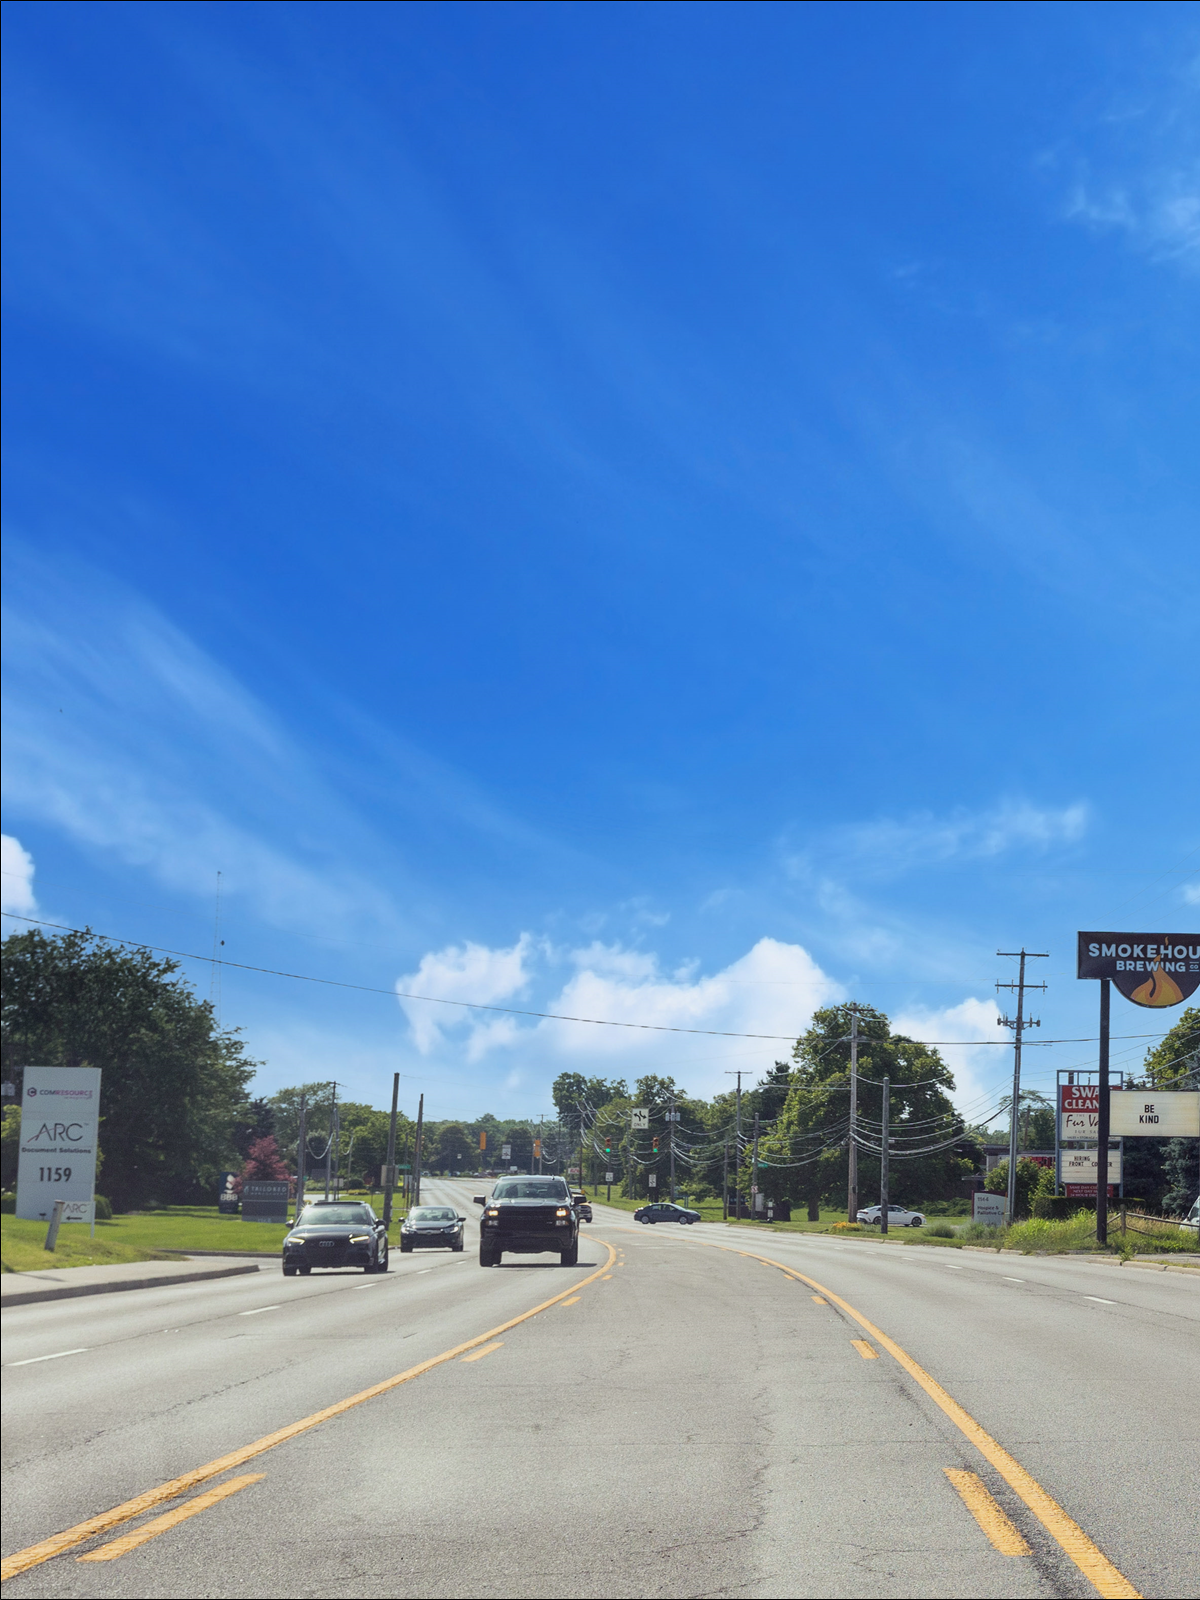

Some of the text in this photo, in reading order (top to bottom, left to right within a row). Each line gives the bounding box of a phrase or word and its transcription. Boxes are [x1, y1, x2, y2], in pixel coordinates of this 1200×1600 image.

[1116, 960, 1185, 972] BREWING
[1071, 1086, 1100, 1098] SWA
[1064, 1099, 1100, 1109] CLEAN
[1144, 1104, 1155, 1113] BE
[1066, 1114, 1085, 1128] Fur
[1139, 1115, 1160, 1124] KIND
[33, 1123, 83, 1142] ARC
[39, 1167, 72, 1182] 1159
[63, 1203, 88, 1214] ARC
